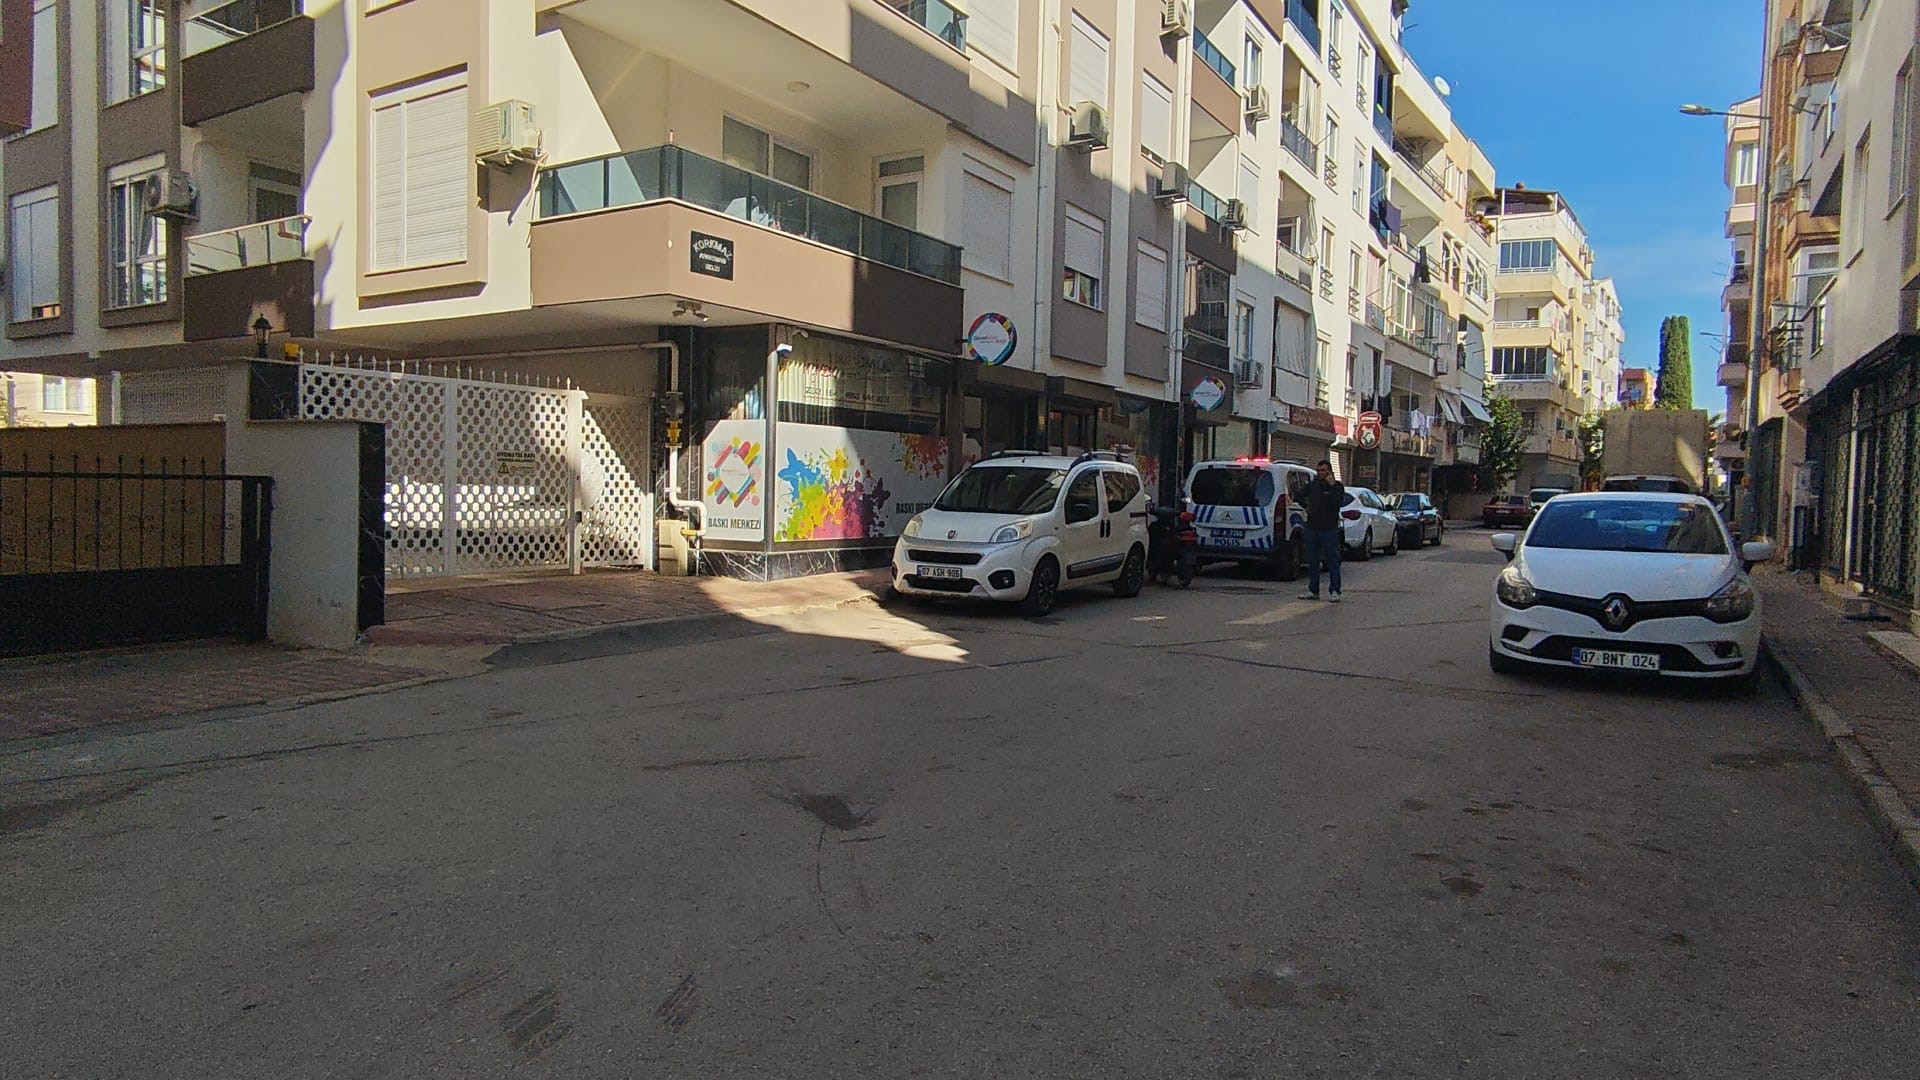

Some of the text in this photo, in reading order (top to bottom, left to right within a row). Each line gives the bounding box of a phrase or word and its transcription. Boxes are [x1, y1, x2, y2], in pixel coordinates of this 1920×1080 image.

[693, 239, 732, 261] KORKMAZ
[708, 518, 728, 528] BASKI
[1581, 651, 1656, 668] 07 BNT 024
